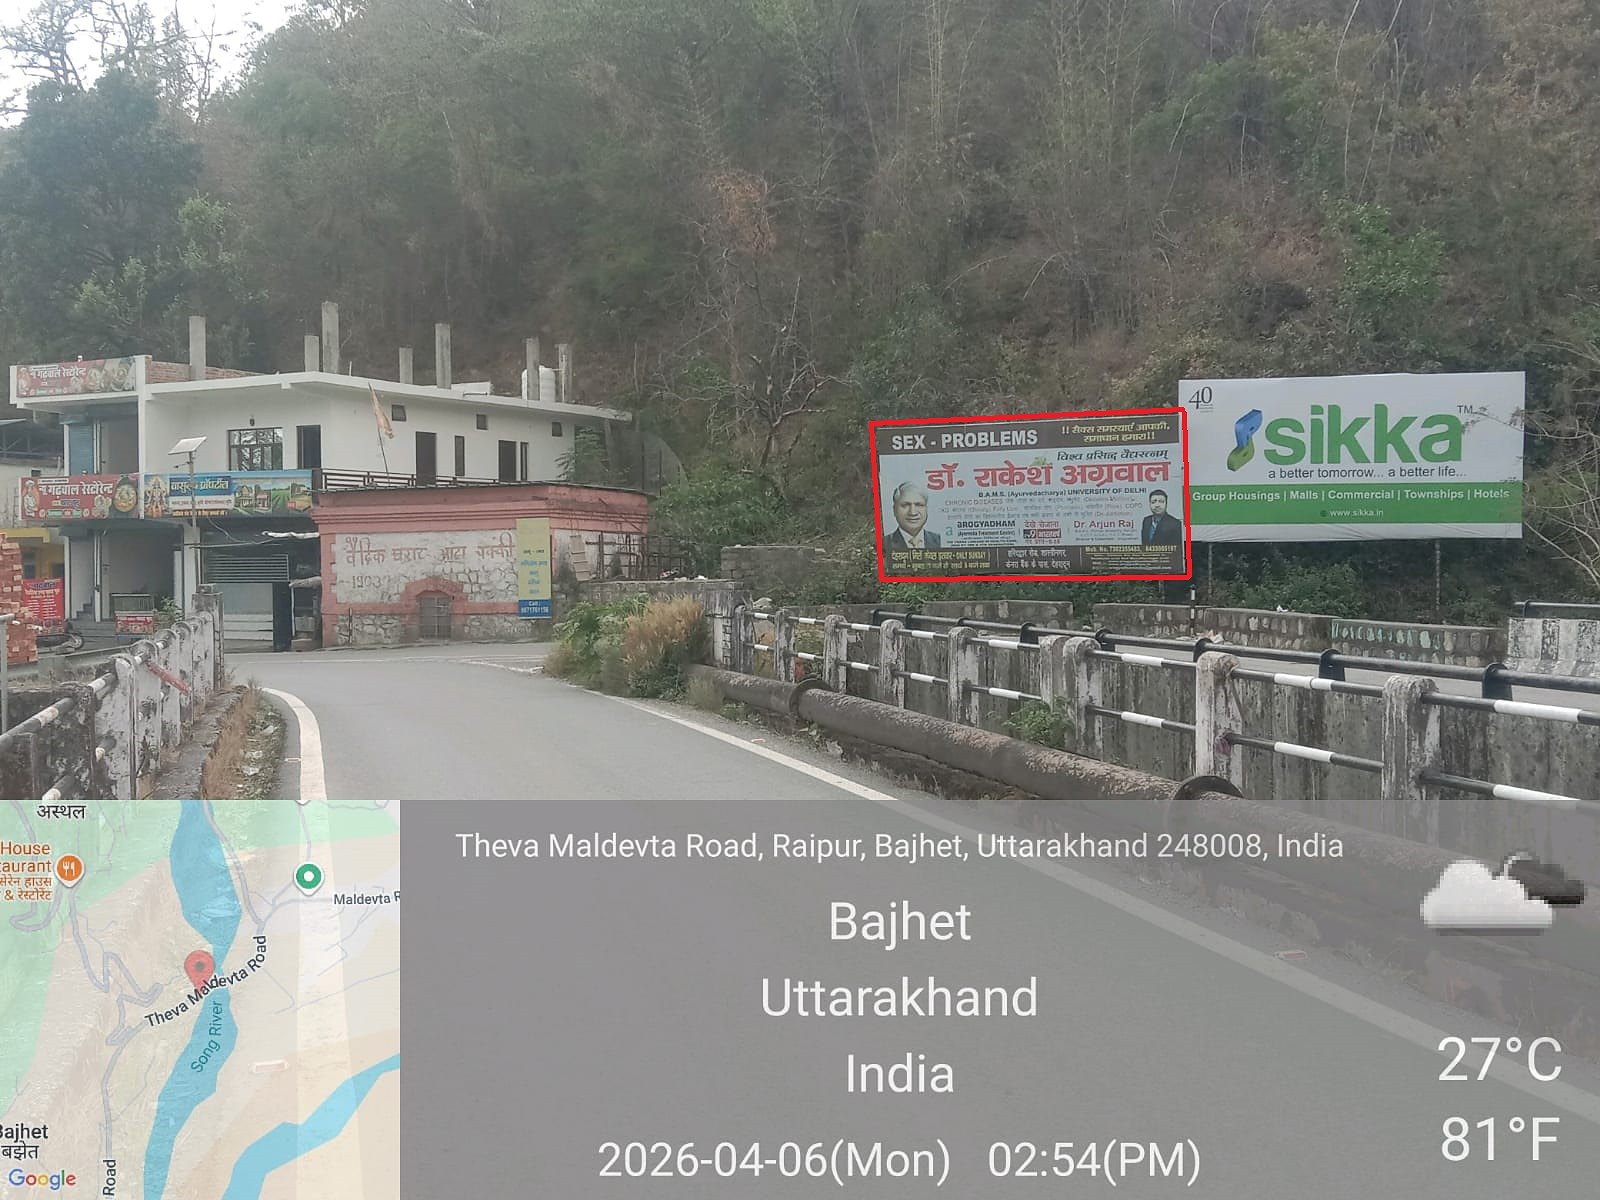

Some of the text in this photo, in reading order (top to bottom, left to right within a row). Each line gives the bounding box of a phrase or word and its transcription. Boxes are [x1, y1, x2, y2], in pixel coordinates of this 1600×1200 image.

[1188, 386, 1213, 410] 40
[891, 434, 926, 451] SEX
[941, 429, 1039, 449] PROBLEMS
[1264, 404, 1473, 466] sikka TM
[1056, 452, 1083, 461] विश्व
[924, 459, 1172, 491] डॉ. राकेश अग्रवाल
[1268, 471, 1276, 479] a
[1280, 468, 1314, 479] better
[1388, 468, 1396, 478] a
[1400, 467, 1436, 478] better
[1067, 488, 1111, 496] UNIVERSITY
[1192, 488, 1510, 502] Group Housings Malls Commercial Townships Hotels
[1329, 508, 1384, 517] www.sikka.in
[1089, 520, 1116, 530] Arjun
[1118, 519, 1135, 529] Raj
